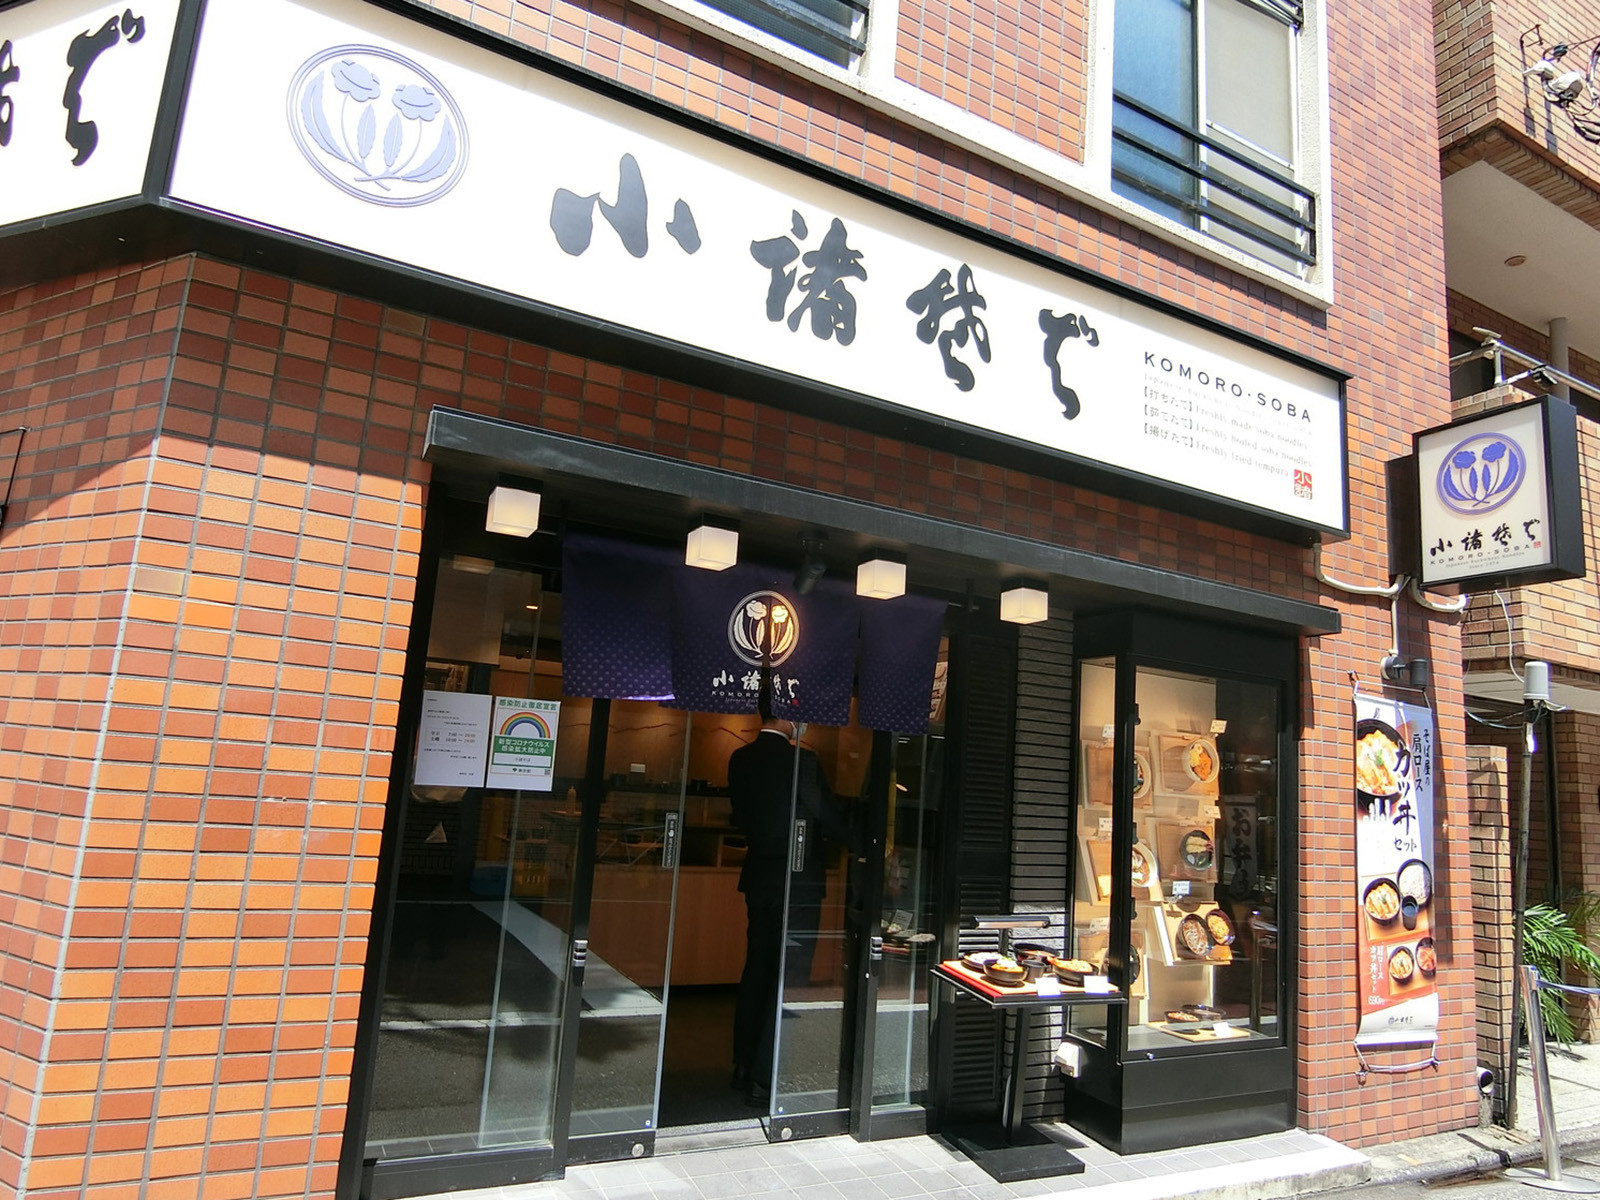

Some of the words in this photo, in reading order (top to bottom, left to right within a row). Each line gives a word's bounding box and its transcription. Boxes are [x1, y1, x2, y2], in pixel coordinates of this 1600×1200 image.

[498, 738, 550, 748] 新型コロナウイルス
[501, 745, 546, 755] 感染拡大防止中
[1412, 733, 1423, 792] 肩ロース
[1423, 728, 1431, 785] そば屋の
[1394, 837, 1417, 853] セット
